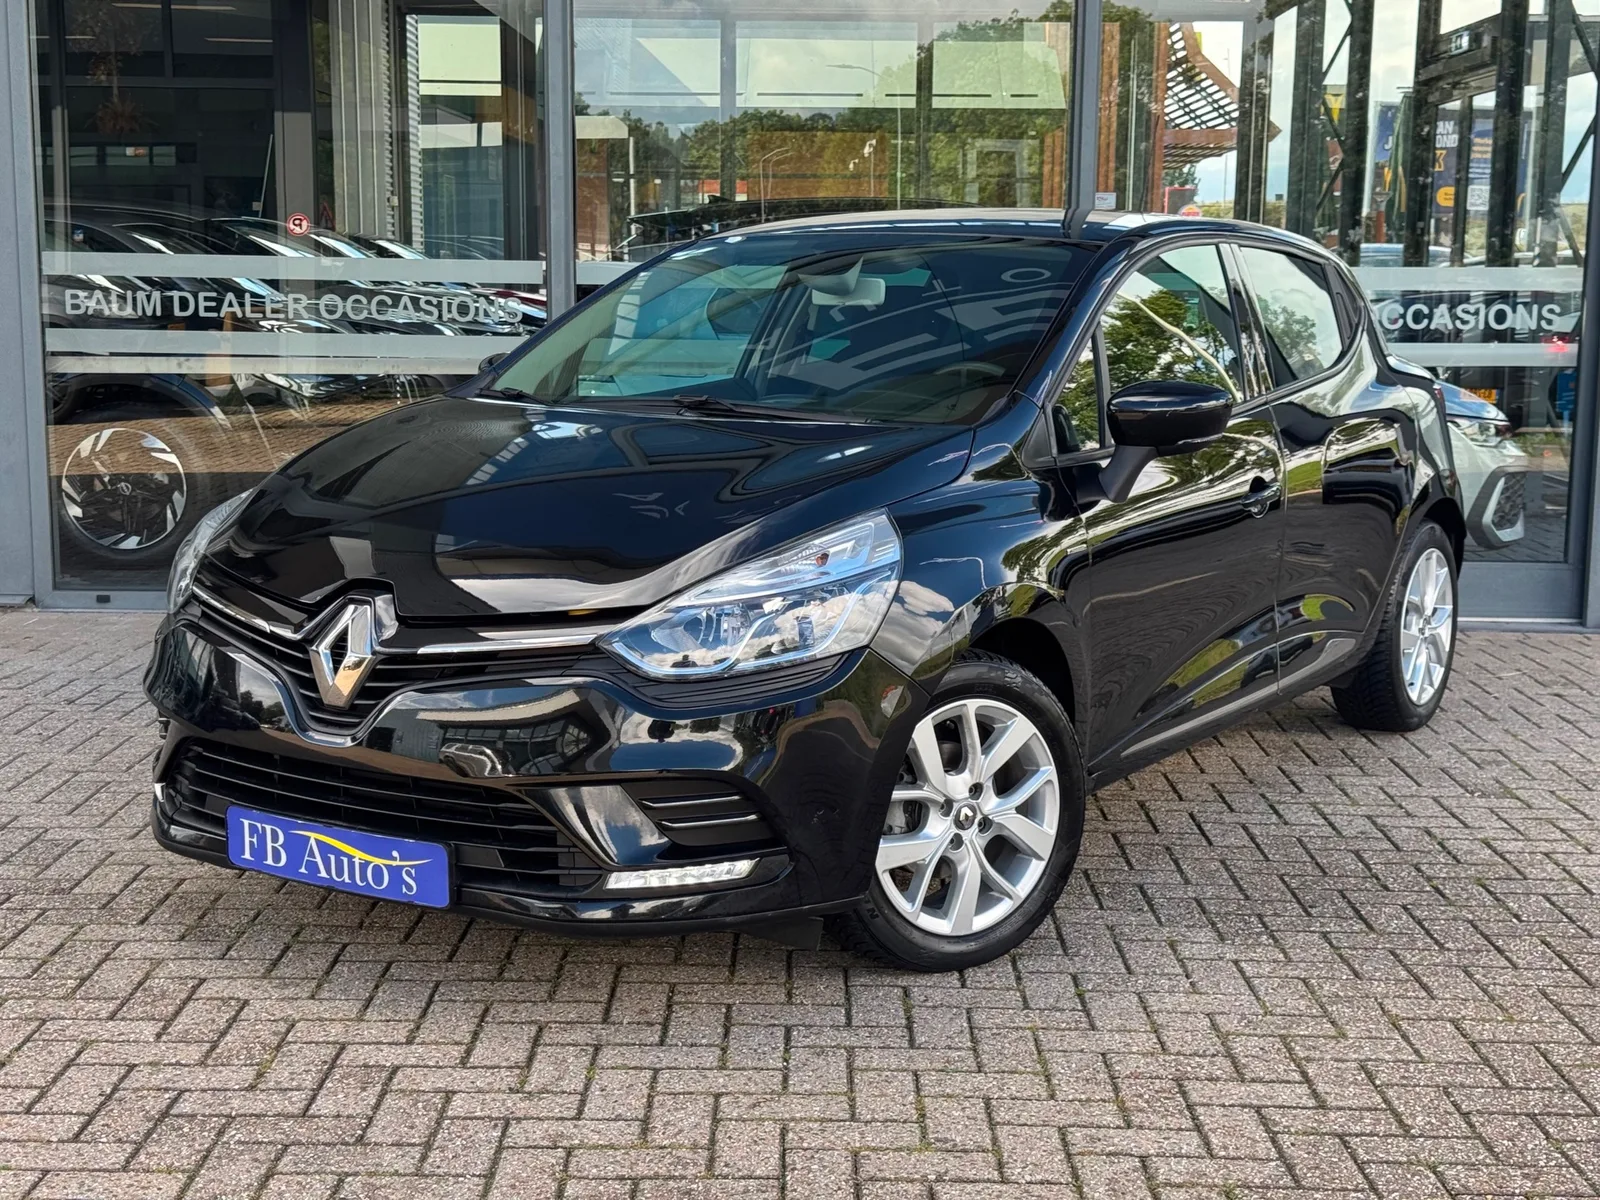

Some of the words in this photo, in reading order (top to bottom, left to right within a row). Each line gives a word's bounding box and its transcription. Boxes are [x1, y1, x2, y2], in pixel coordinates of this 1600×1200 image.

[64, 289, 163, 318] BAUM
[173, 290, 309, 320] DEALER
[319, 293, 524, 324] OCCASIONS
[1374, 302, 1562, 331] CCASIONS
[239, 818, 288, 868] FB
[298, 835, 418, 896] Auto's
